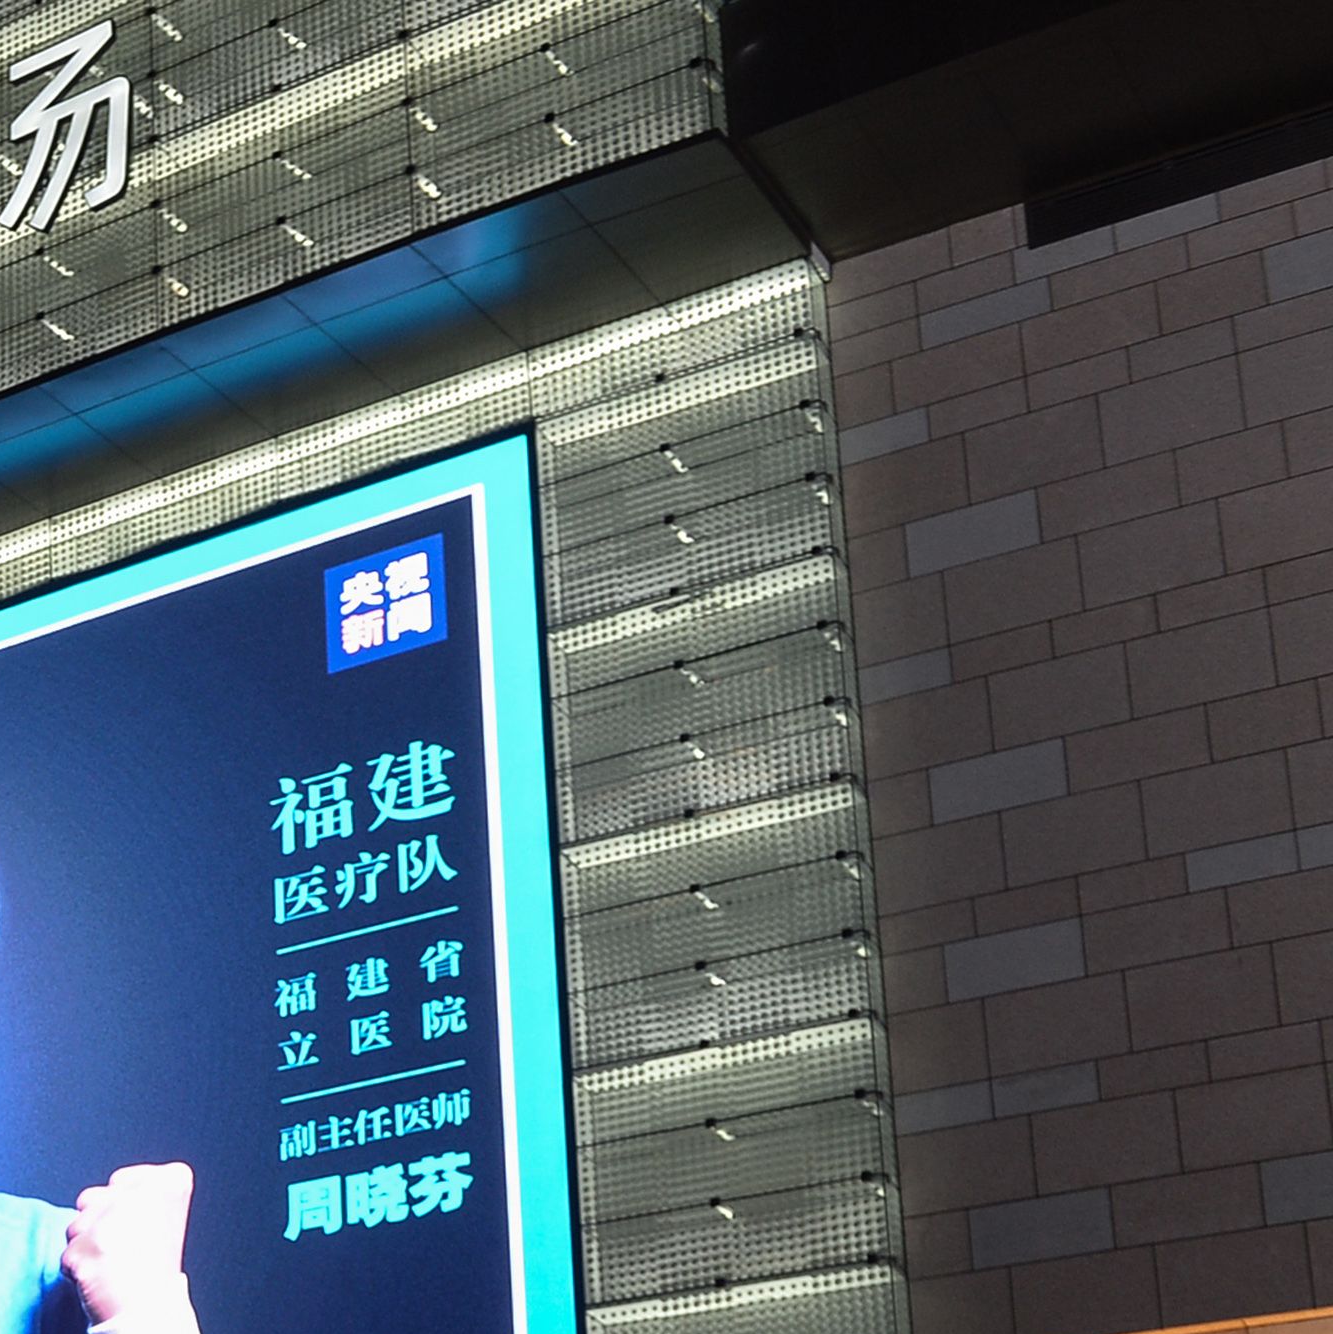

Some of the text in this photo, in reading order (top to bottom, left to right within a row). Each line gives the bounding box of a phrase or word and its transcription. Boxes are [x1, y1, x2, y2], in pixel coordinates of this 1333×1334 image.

[340, 551, 431, 616] 央视
[341, 592, 432, 655] 新闻
[269, 739, 457, 857] 福建
[272, 833, 459, 925] 医疗队
[272, 938, 465, 1019] 福建省
[275, 994, 469, 1073] 立医院
[278, 1087, 473, 1162] 副主任医师
[283, 1150, 474, 1243] 周晓芬
